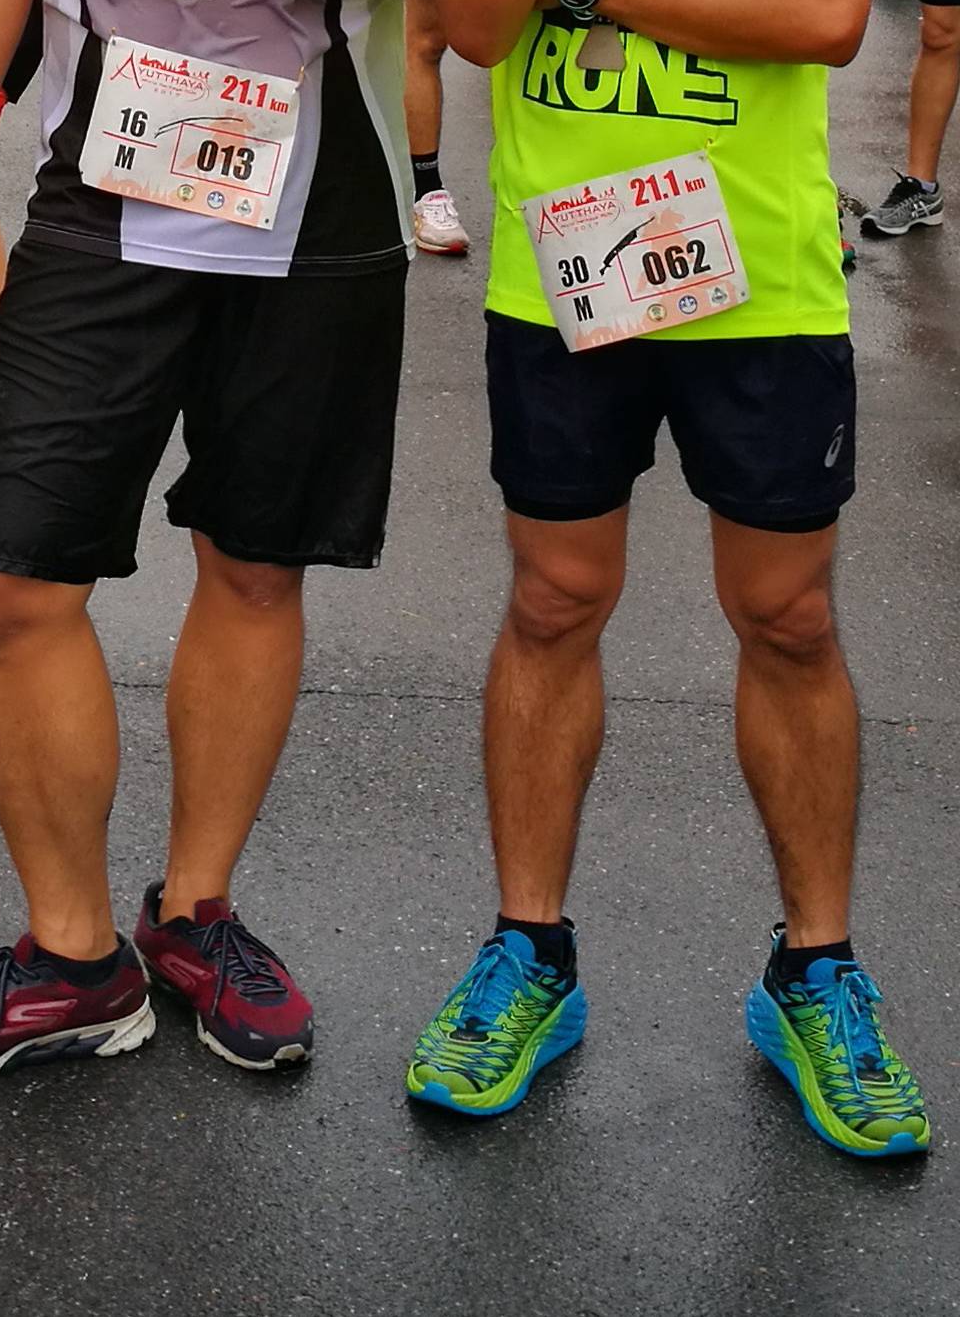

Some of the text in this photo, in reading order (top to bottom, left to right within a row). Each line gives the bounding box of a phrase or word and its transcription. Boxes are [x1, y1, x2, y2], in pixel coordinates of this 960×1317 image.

[110, 49, 204, 90] AYUTTHAYA
[220, 73, 270, 108] 21.1
[269, 97, 289, 114] km
[120, 107, 149, 138] 16
[114, 144, 137, 170] M
[196, 139, 256, 181] 013
[630, 169, 707, 207] 21.1 km
[538, 201, 617, 244] AYUTTHAYA
[558, 255, 590, 288] 30
[642, 239, 712, 286] 062
[573, 295, 594, 322] M
